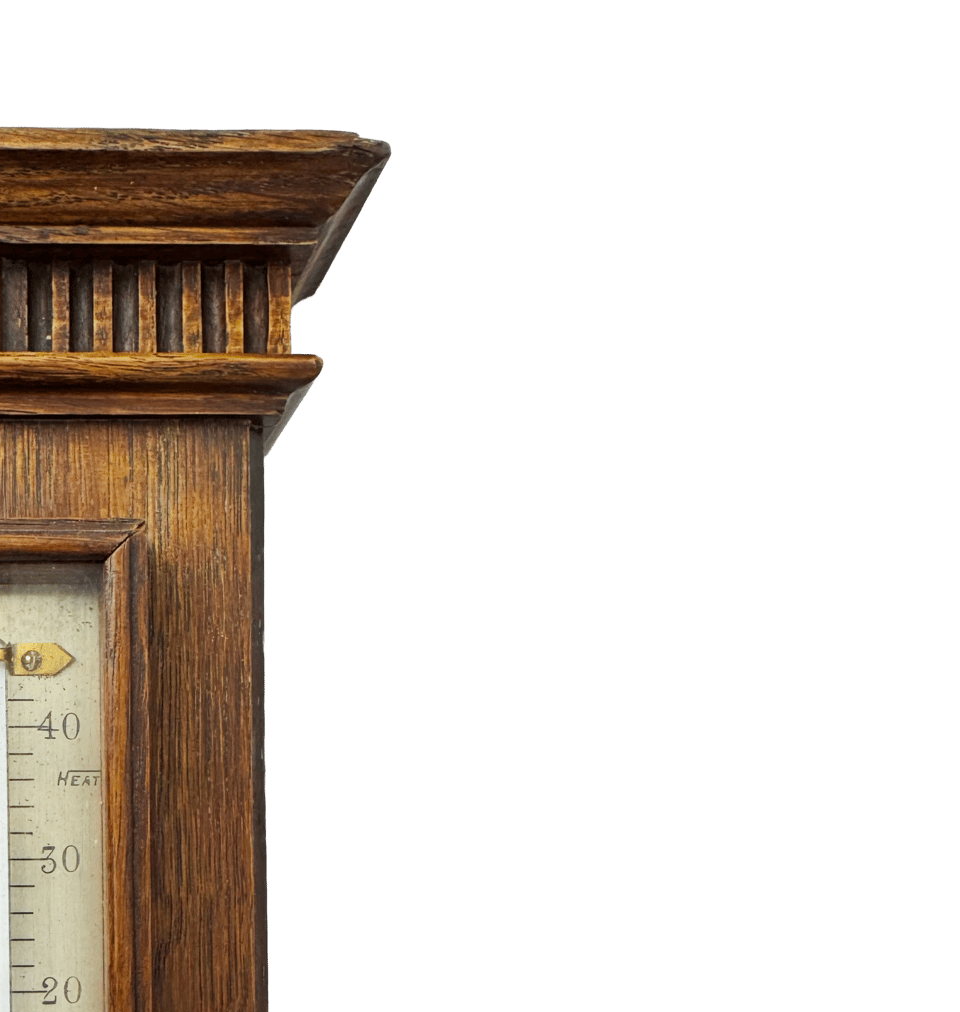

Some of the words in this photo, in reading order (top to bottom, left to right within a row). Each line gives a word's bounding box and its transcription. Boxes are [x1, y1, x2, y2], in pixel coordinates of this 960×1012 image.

[37, 711, 81, 740] 40
[57, 771, 101, 787] HEAT
[41, 845, 81, 874] 30
[41, 976, 82, 1005] 20
